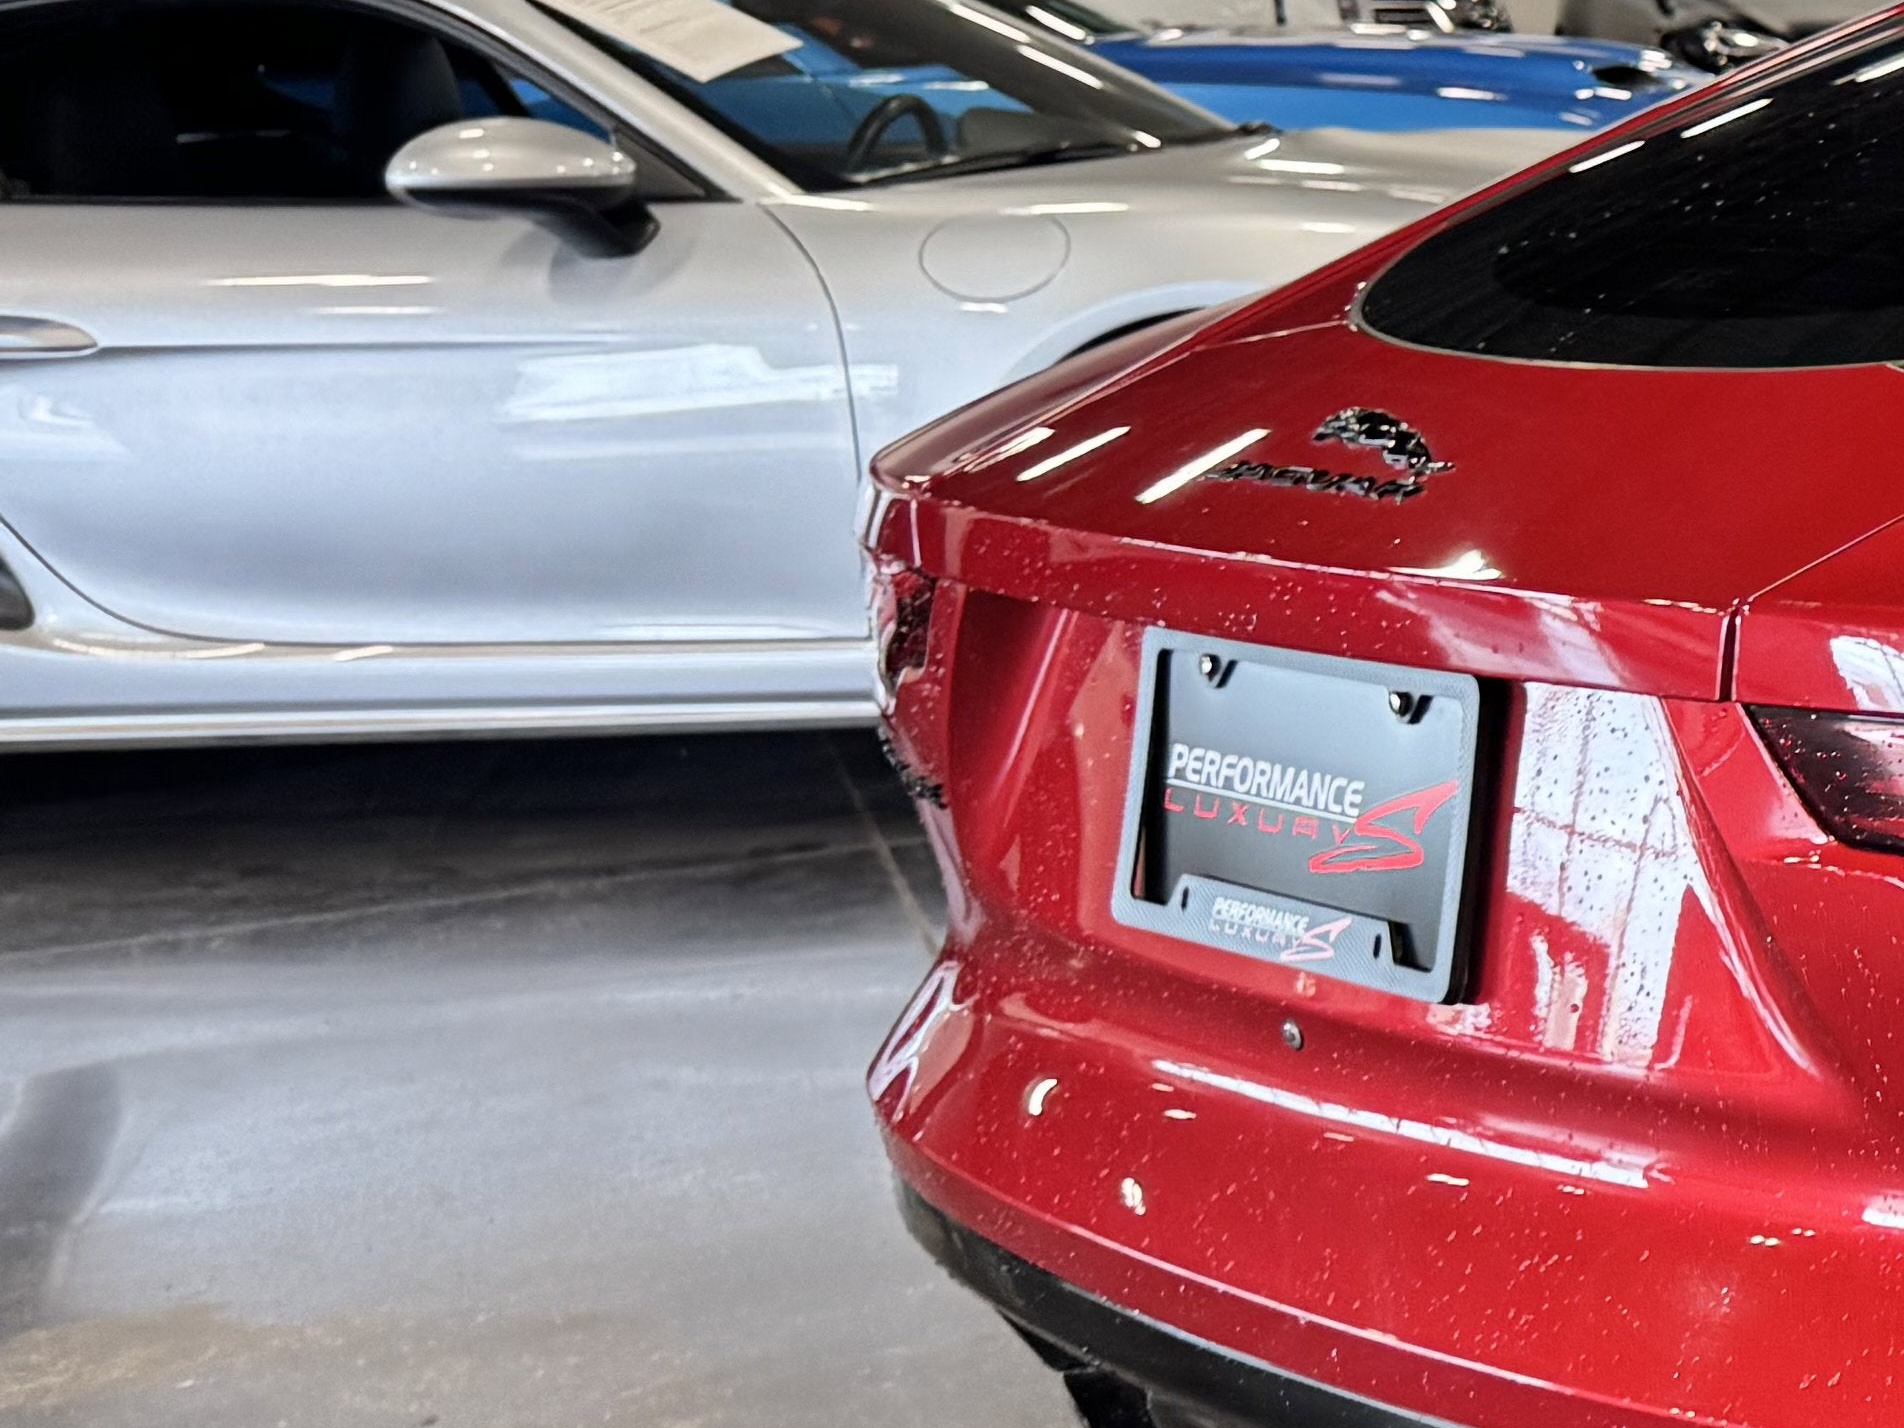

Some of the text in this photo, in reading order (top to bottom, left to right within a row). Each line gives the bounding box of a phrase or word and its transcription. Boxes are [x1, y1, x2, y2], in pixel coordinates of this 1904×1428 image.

[1168, 743, 1365, 817] PERFORMANCE
[1163, 788, 1351, 844] LUXURY
[1212, 897, 1310, 936] PERFORMANCE
